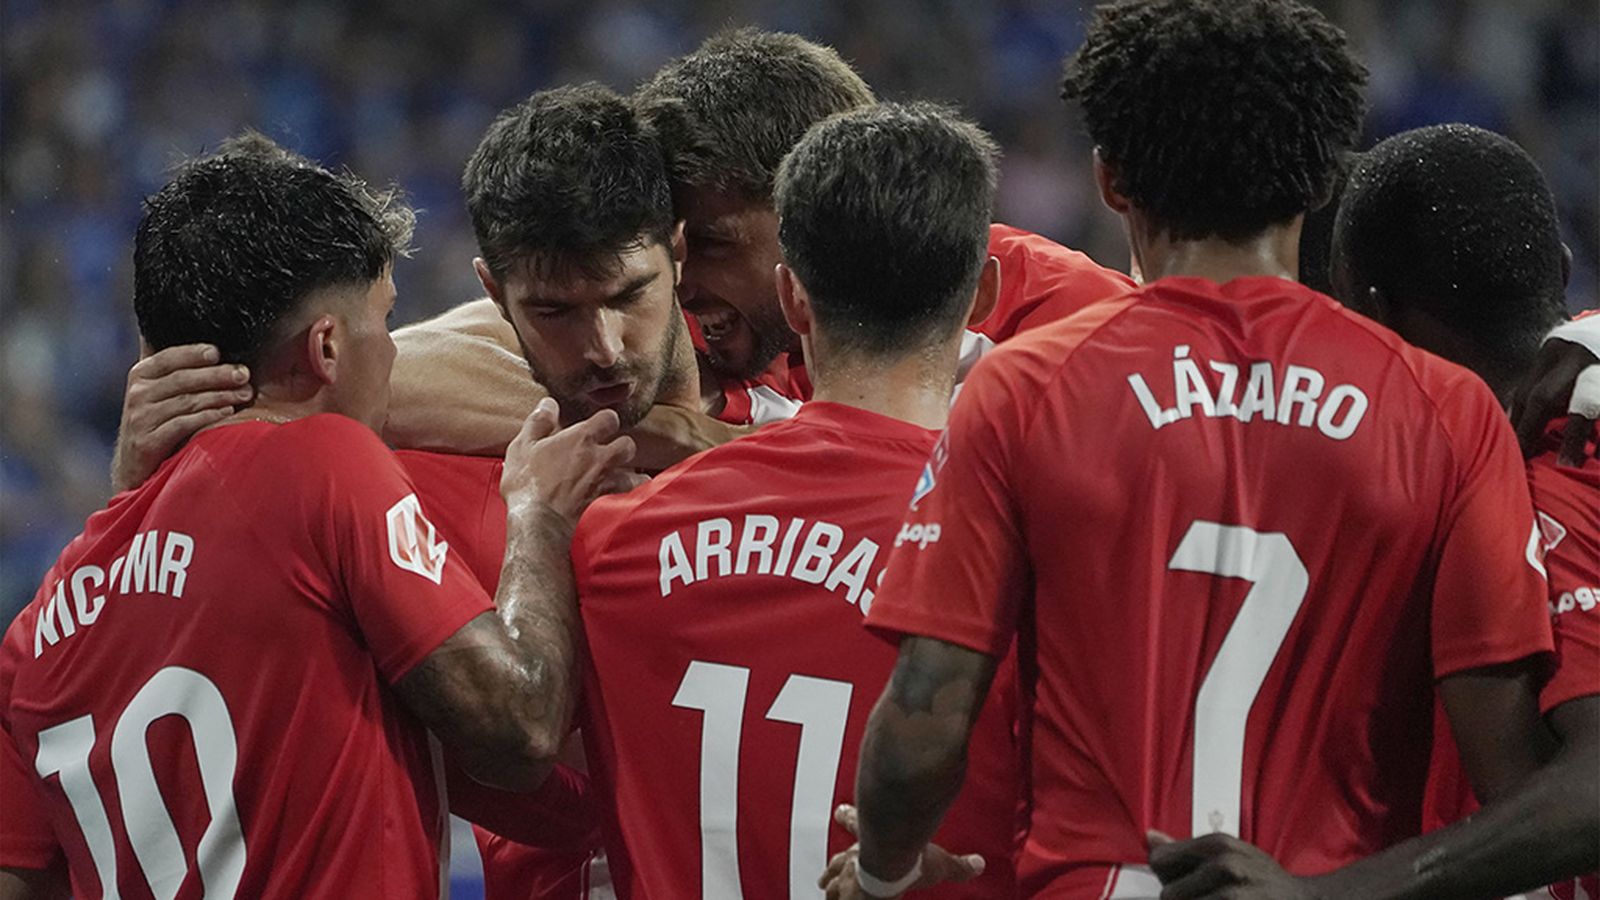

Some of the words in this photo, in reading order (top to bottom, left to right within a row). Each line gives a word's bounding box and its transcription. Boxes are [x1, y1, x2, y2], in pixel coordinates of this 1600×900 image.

[1127, 344, 1369, 440] LÁZARO
[35, 666, 247, 900] 10
[671, 660, 854, 900] 11
[1168, 520, 1309, 838] 7
